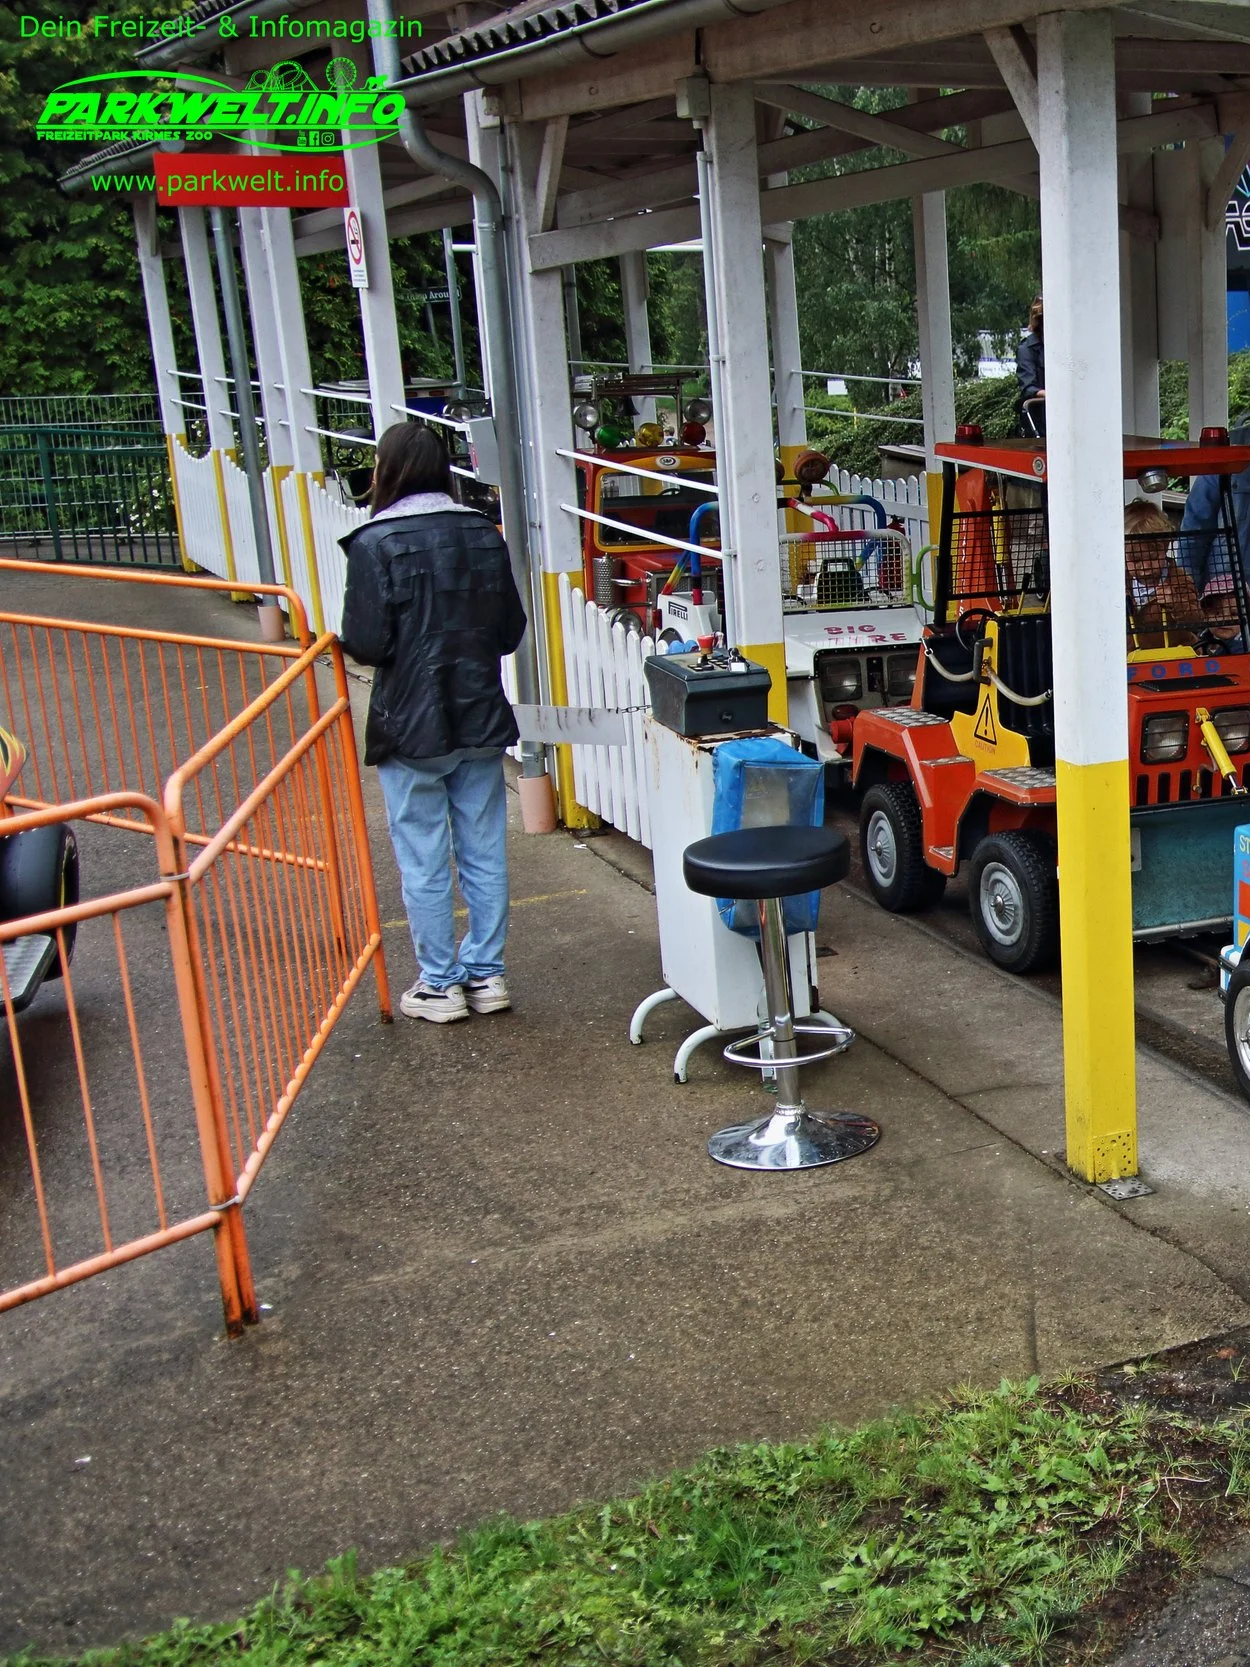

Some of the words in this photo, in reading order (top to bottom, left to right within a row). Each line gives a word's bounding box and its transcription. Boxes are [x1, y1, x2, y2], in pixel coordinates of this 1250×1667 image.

[668, 601, 688, 620] PIRELLI
[824, 625, 876, 634] BIG
[1127, 660, 1220, 681] FORD
